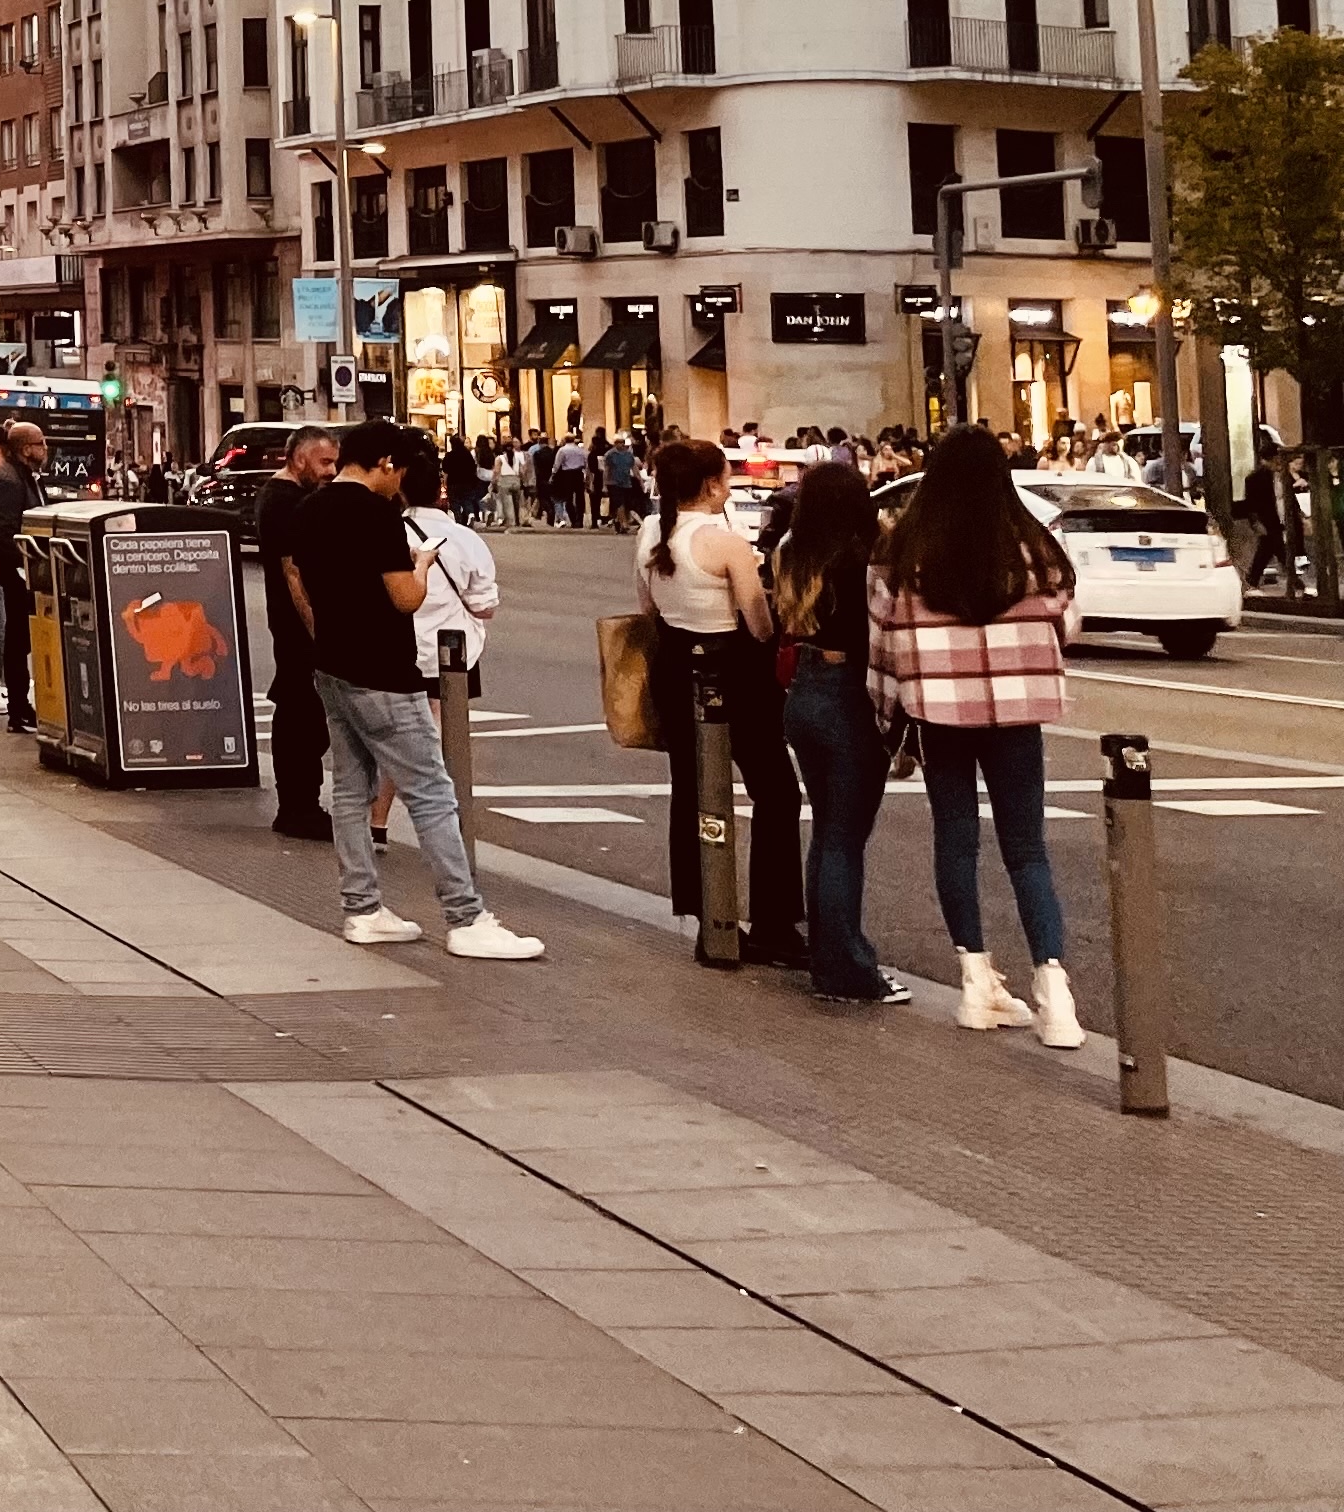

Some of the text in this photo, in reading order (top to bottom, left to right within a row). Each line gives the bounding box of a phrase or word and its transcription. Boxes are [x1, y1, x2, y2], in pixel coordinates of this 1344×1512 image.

[786, 315, 850, 327] DAN JOHN
[110, 538, 211, 551] Cada papelera tiene
[111, 549, 220, 562] su cenicero. Deposita
[112, 562, 200, 574] dentro las colillas.
[123, 700, 139, 712] No
[140, 700, 156, 711] las
[182, 699, 191, 710] al
